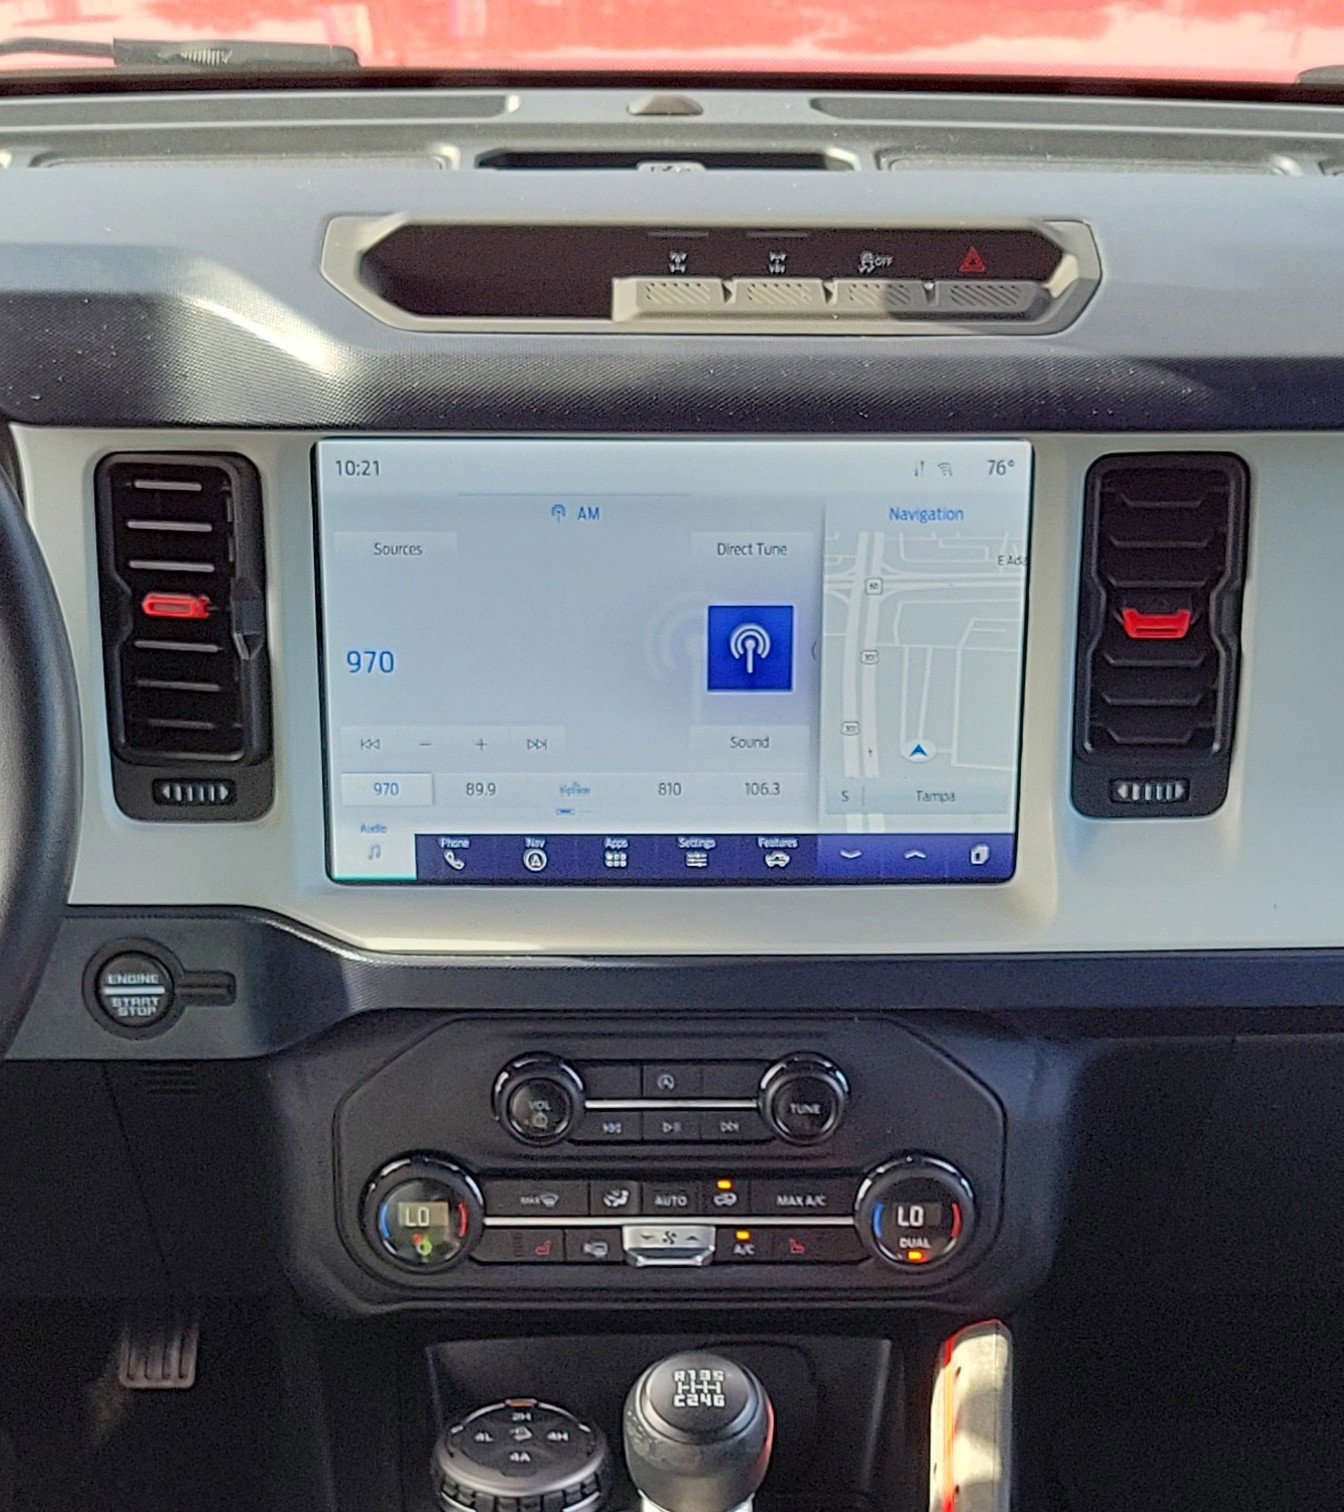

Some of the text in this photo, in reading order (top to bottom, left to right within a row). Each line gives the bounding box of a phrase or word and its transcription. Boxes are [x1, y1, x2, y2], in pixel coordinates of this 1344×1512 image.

[335, 459, 380, 476] 10:21
[577, 506, 600, 520] AM
[889, 507, 964, 523] Navigation
[374, 542, 423, 556] Sources
[717, 543, 787, 556] Direct Tune
[346, 650, 395, 674] 970
[730, 736, 770, 749] Sound
[373, 782, 399, 796] 970
[466, 782, 496, 796] 89.9
[658, 783, 682, 796] 810
[745, 783, 781, 796] 106.3
[917, 790, 956, 804] Tampa
[360, 823, 387, 834] Audio
[441, 837, 470, 849] Phone
[525, 838, 545, 849] Nav
[605, 837, 629, 850] Apps
[678, 837, 716, 850] Settings
[758, 837, 798, 849] Features
[107, 974, 159, 984] ENGINE
[112, 997, 159, 1007] START
[118, 1007, 157, 1017] STOP
[790, 1103, 821, 1114] TUNE
[654, 1195, 688, 1206] AUTO
[777, 1195, 804, 1206] MAX
[898, 1205, 924, 1227] LO
[899, 1238, 930, 1249] DUAL
[547, 1431, 569, 1442] 4H
[509, 1452, 531, 1462] 4A
